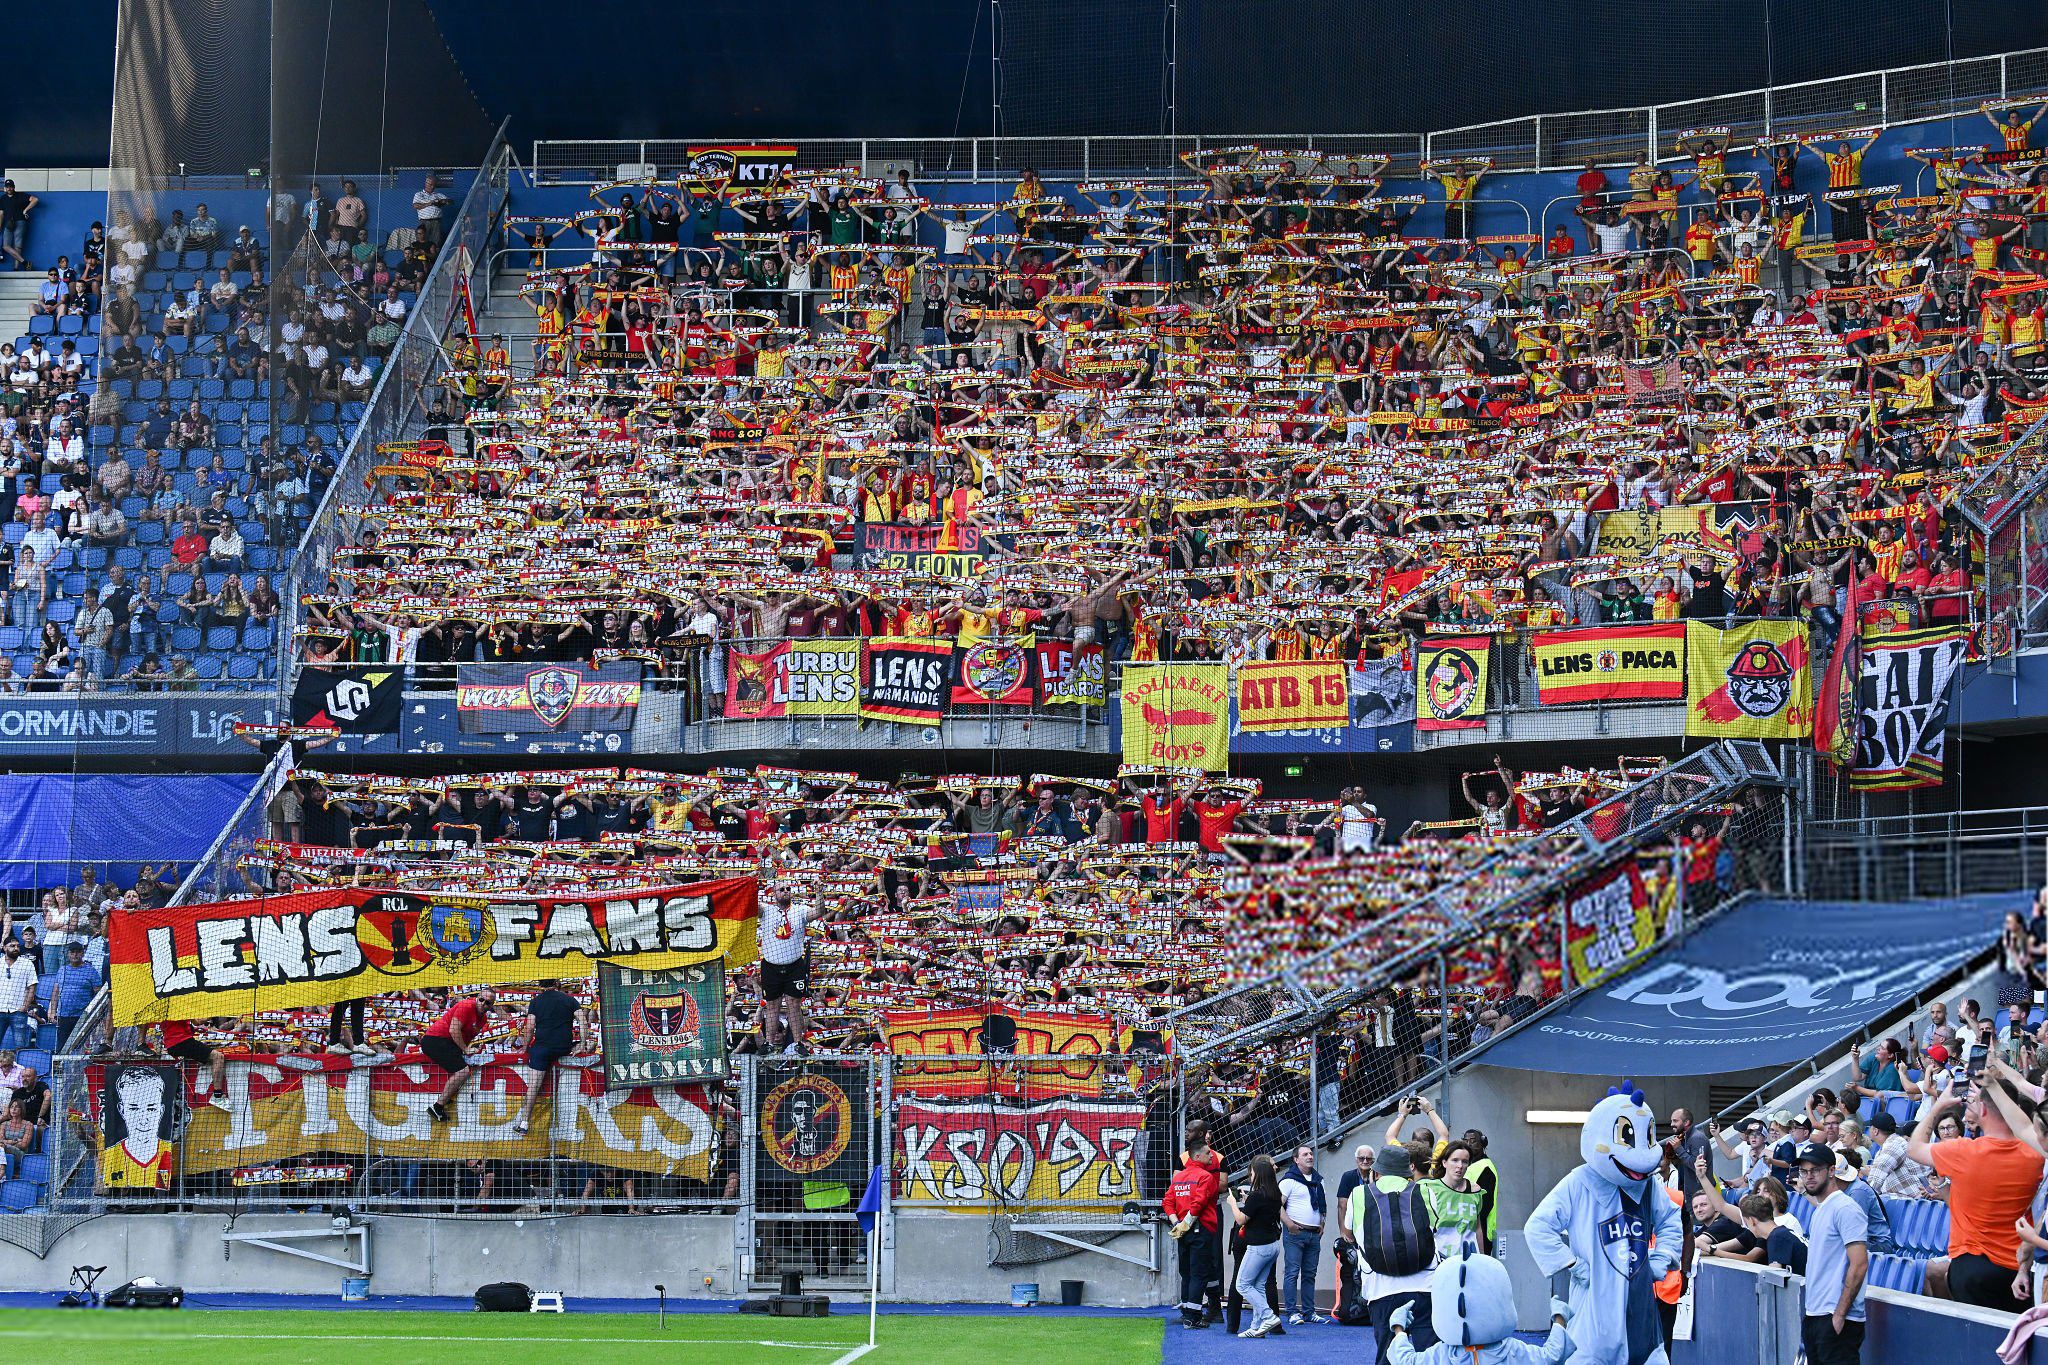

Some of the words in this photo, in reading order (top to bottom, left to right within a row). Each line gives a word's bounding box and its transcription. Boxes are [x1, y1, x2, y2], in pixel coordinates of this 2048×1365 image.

[1848, 129, 1873, 138] FANS
[1987, 152, 2016, 162] SANG
[2027, 150, 2041, 159] OR
[1825, 191, 1854, 199] LENS
[1868, 185, 1899, 193] FANS
[1241, 325, 1273, 334] SANG
[1636, 387, 1680, 398] TOUJOURS
[1510, 407, 1538, 416] SANG
[1445, 419, 1470, 430] LENS
[747, 429, 762, 437] OR
[404, 454, 435, 465] SANG
[497, 612, 528, 622] LENS
[548, 614, 579, 624] FANS
[1431, 624, 1460, 633] LENS
[1476, 624, 1505, 632] FANS
[773, 651, 856, 673] TURBU
[1542, 652, 1593, 676] LENS
[1622, 650, 1677, 670] PACA
[875, 658, 942, 690] LENS
[463, 686, 524, 708] WOLF
[583, 682, 635, 705] 2017
[773, 674, 856, 703] LENS
[1124, 675, 1227, 705] BOLLAERT
[1241, 676, 1299, 711] ATB
[1308, 674, 1345, 706] 15
[1151, 741, 1206, 760] BOYS
[372, 777, 400, 786] LENS
[574, 783, 604, 792] LENS
[623, 782, 656, 792] FANS
[939, 778, 971, 788] LENS
[987, 777, 1020, 787] FANS
[857, 810, 890, 818] LENS
[908, 809, 940, 818] FANS
[381, 896, 408, 911] RCL
[147, 905, 365, 997] LENS
[490, 895, 716, 960] FANS
[619, 965, 707, 986] LENS
[642, 1036, 667, 1045] LENS
[669, 1034, 688, 1045] 1906
[1663, 1035, 1786, 1047] RESTAURANTS
[610, 1058, 723, 1082] MCMVI
[193, 1060, 713, 1158] TIGERS
[901, 1124, 1035, 1201] KSO
[243, 1170, 279, 1183] LENS
[305, 1168, 346, 1180] FANS
[1608, 1222, 1643, 1239] HAC
